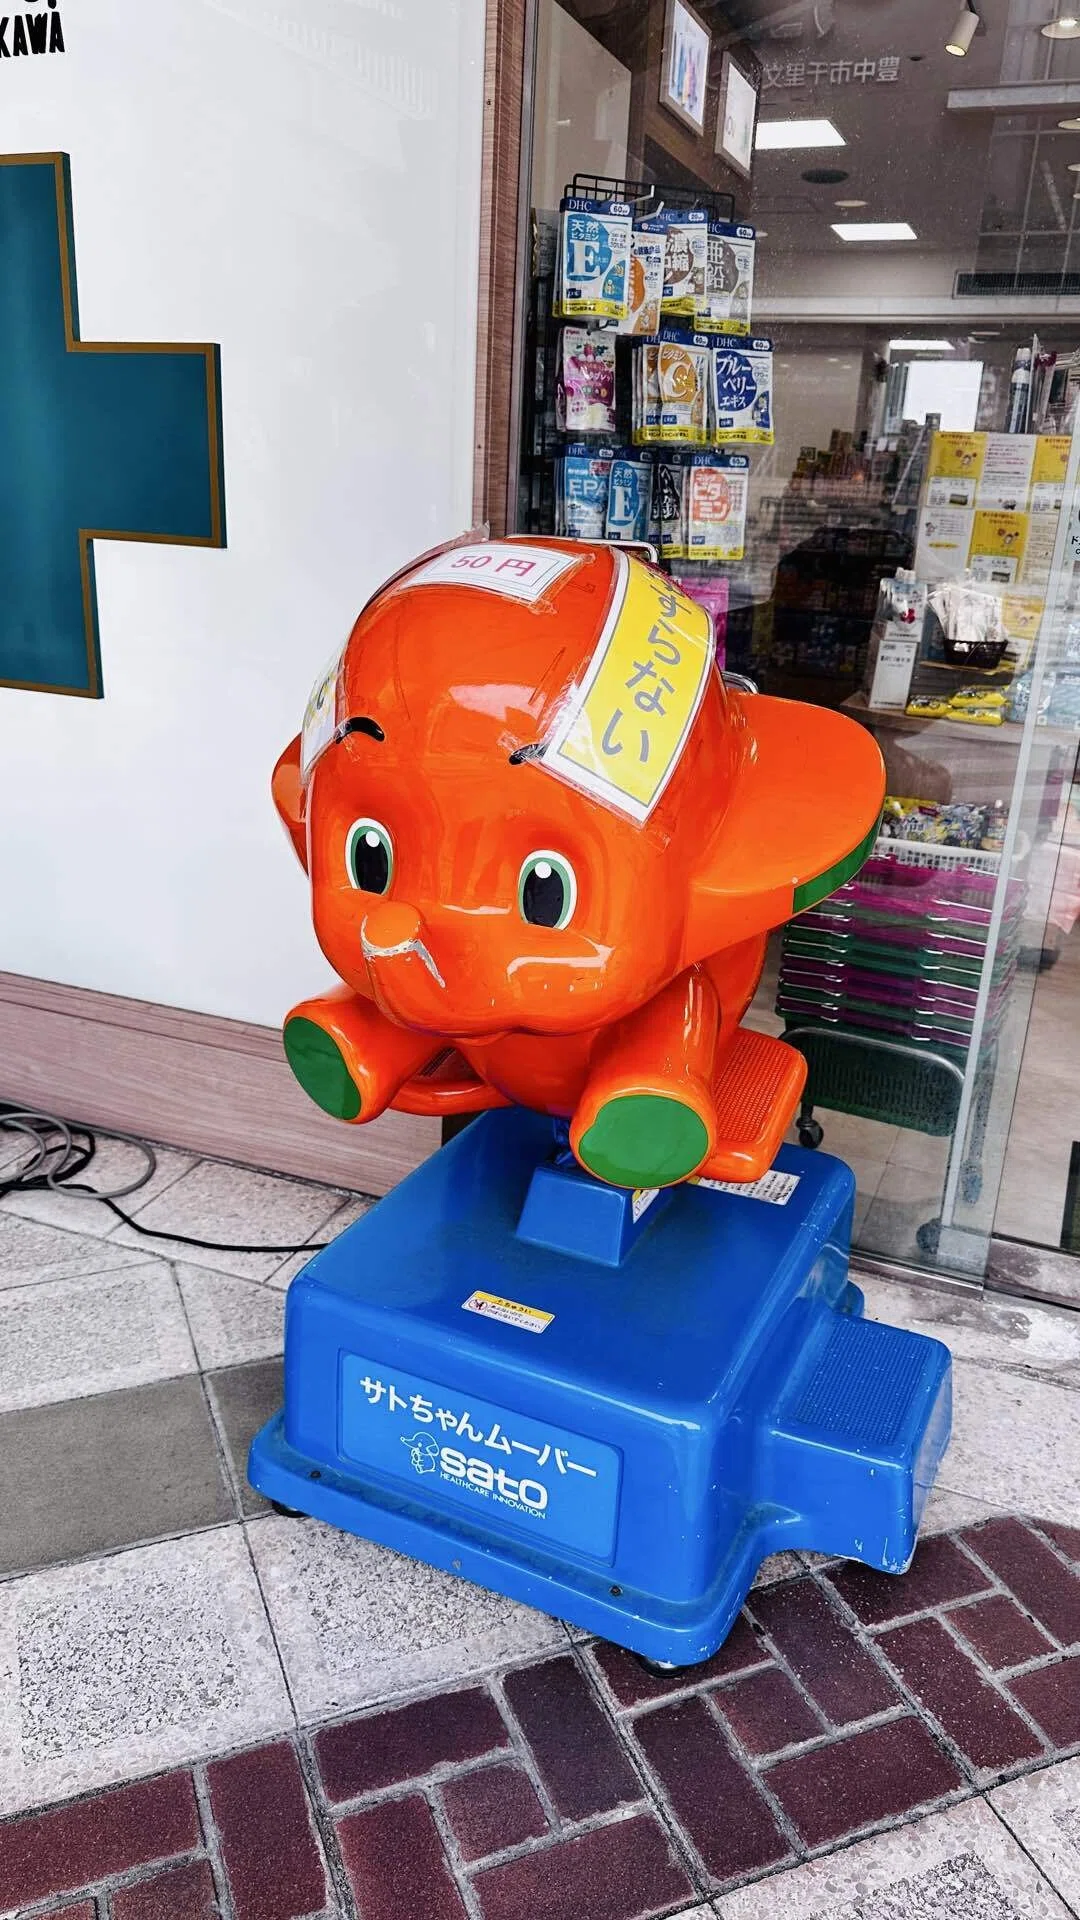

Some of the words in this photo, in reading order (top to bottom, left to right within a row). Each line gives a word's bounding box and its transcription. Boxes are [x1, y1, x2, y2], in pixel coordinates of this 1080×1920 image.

[0, 11, 65, 57] KAWA
[568, 200, 592, 211] DHC
[572, 219, 600, 233] 天然
[571, 232, 600, 240] ビタミン
[568, 240, 601, 276] E
[664, 331, 679, 341] DHC
[717, 337, 737, 347] DHC
[717, 355, 752, 376] ブルー
[662, 362, 692, 398] C
[722, 376, 756, 395] ベリー
[720, 396, 746, 409] エキス
[568, 446, 585, 456] DHC
[694, 455, 712, 465] DHC
[568, 479, 609, 498] EPA
[611, 485, 634, 520] E
[359, 1376, 597, 1478] サトちゃんムーバー
[440, 1447, 548, 1511] sato
[440, 1471, 490, 1498] HEALTHCARE
[492, 1492, 546, 1520] INNOVATION
